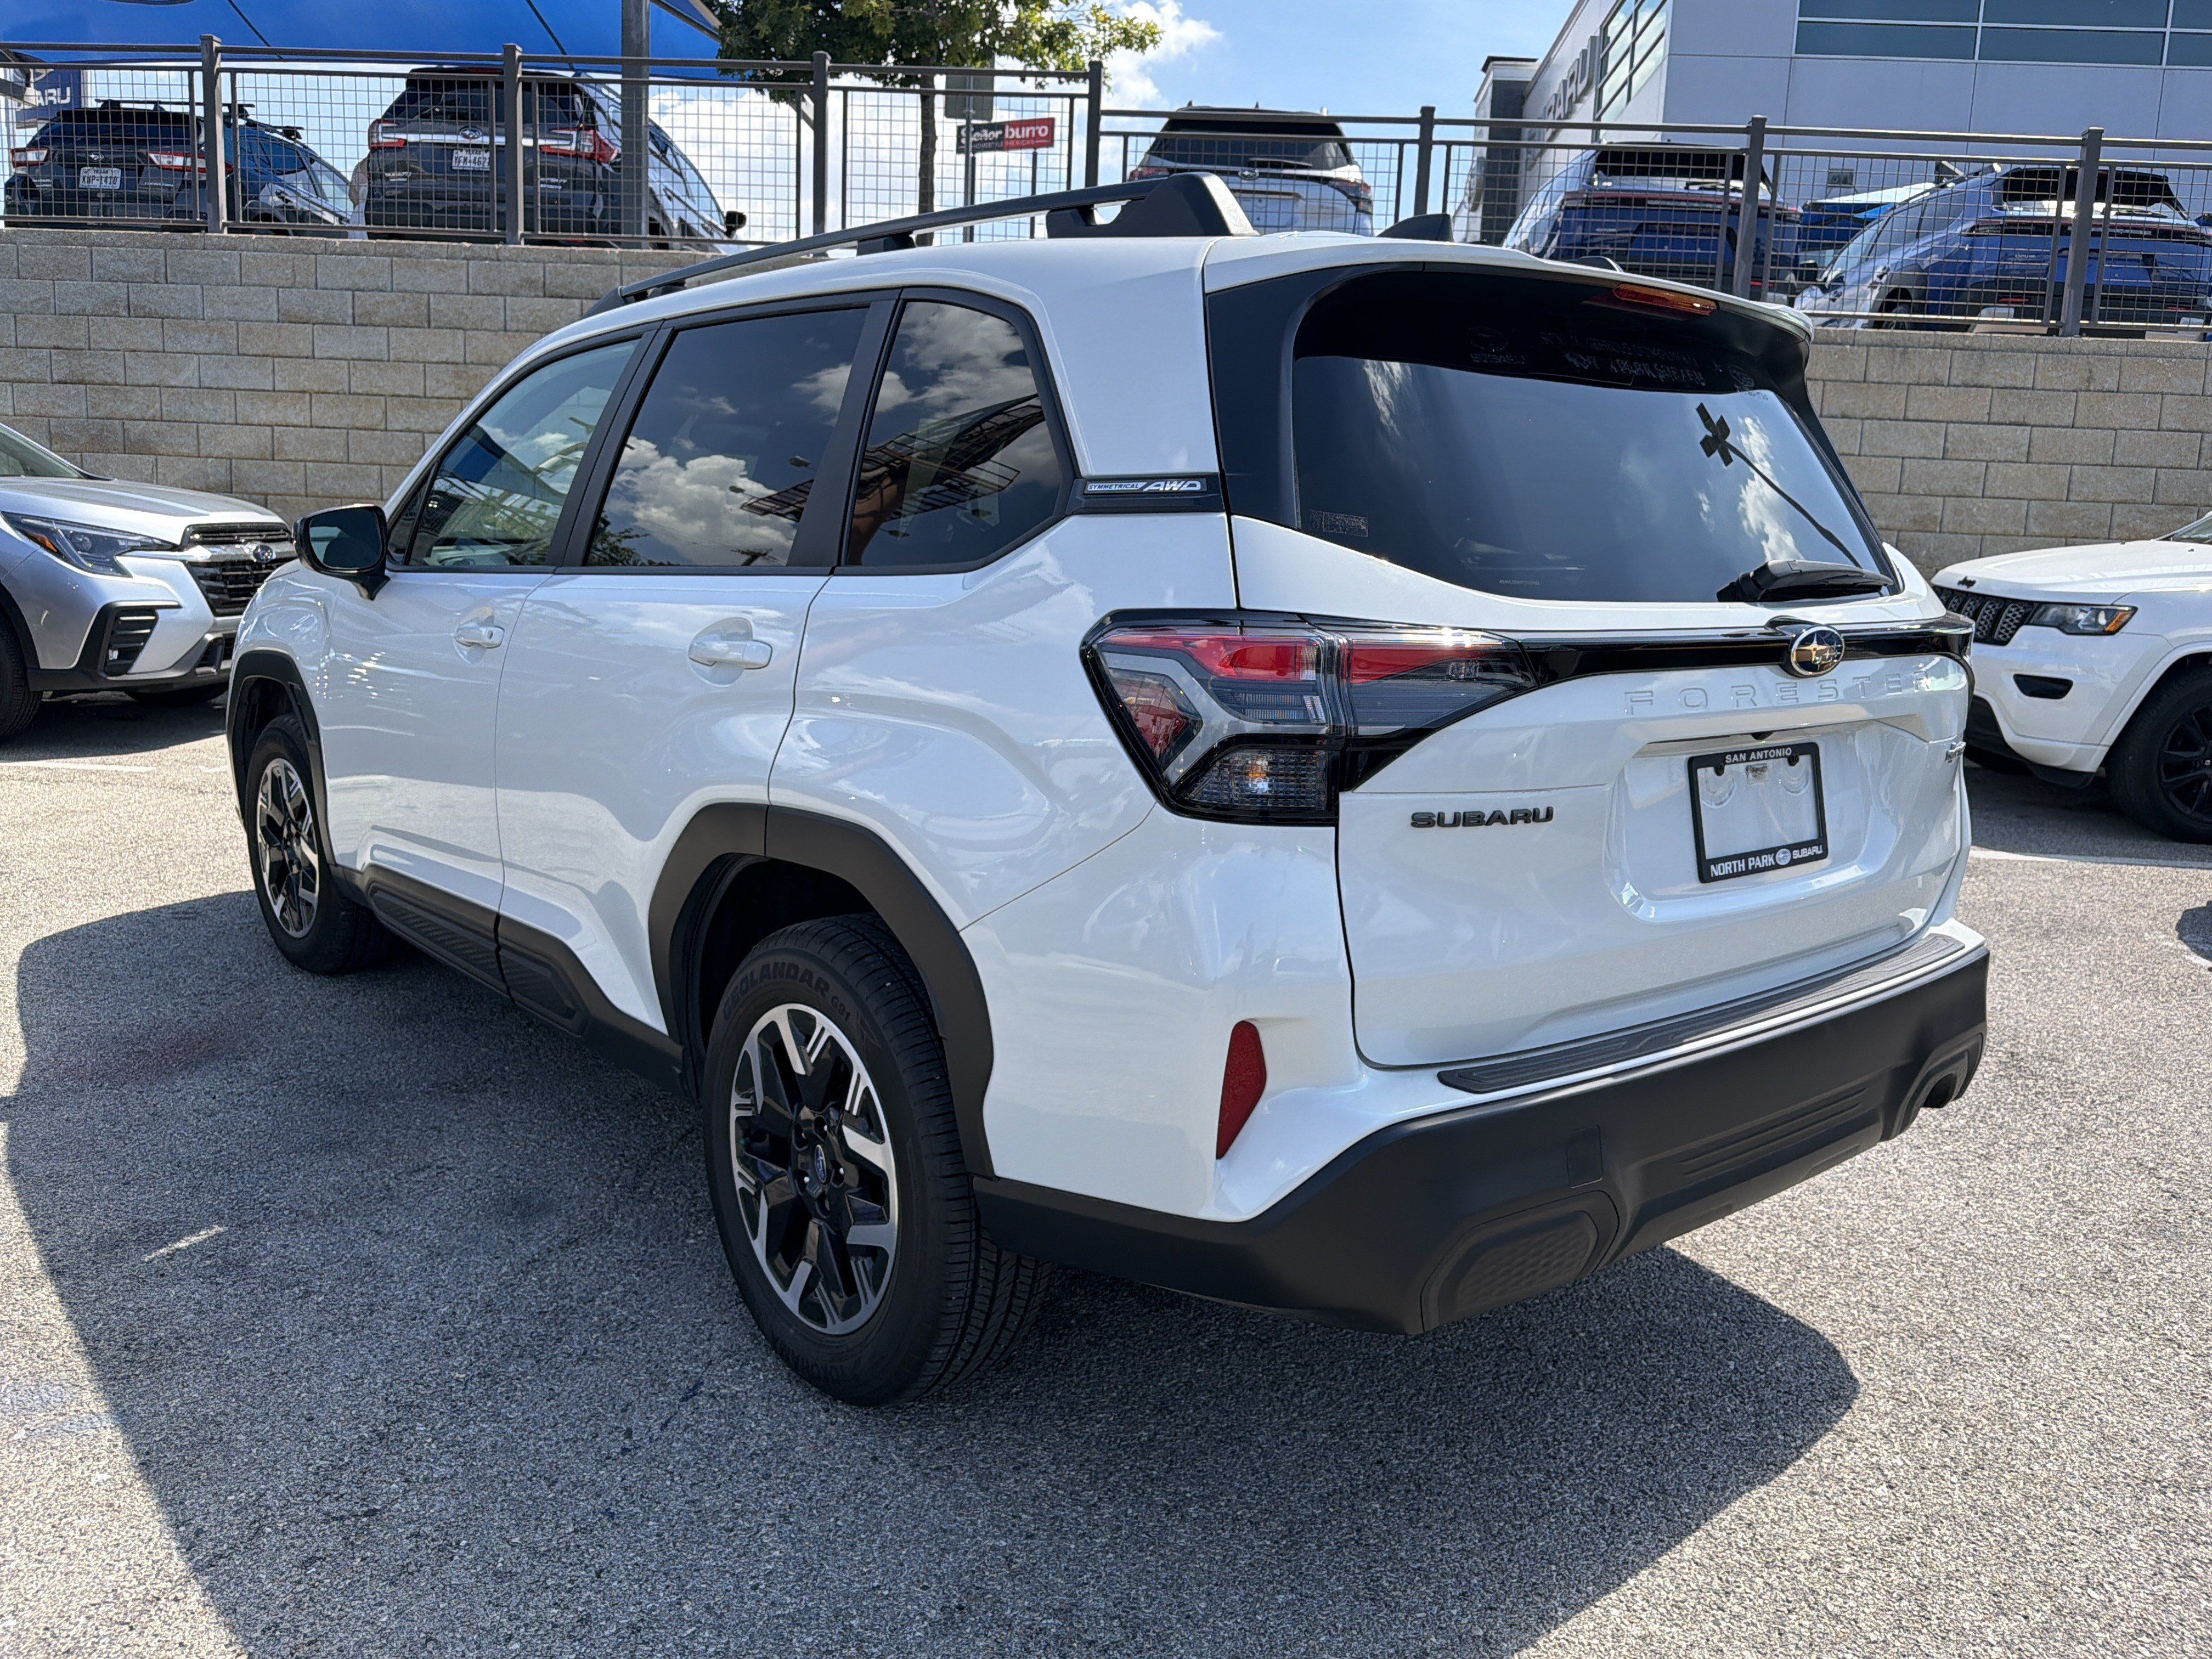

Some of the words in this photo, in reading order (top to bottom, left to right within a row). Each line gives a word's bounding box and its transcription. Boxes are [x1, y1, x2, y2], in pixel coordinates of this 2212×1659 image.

[1005, 124, 1048, 139] burro
[1143, 481, 1201, 492] AWD
[1624, 671, 1929, 715] FORESTER
[1725, 754, 1746, 764] SAN
[1750, 747, 1792, 761] ANTONIO
[1410, 806, 1554, 828] SUBARU
[1710, 859, 1746, 877] NORTH
[1748, 853, 1775, 870] PARK
[1792, 845, 1823, 860] SUBARU
[723, 961, 830, 1020] GEOLANDAR
